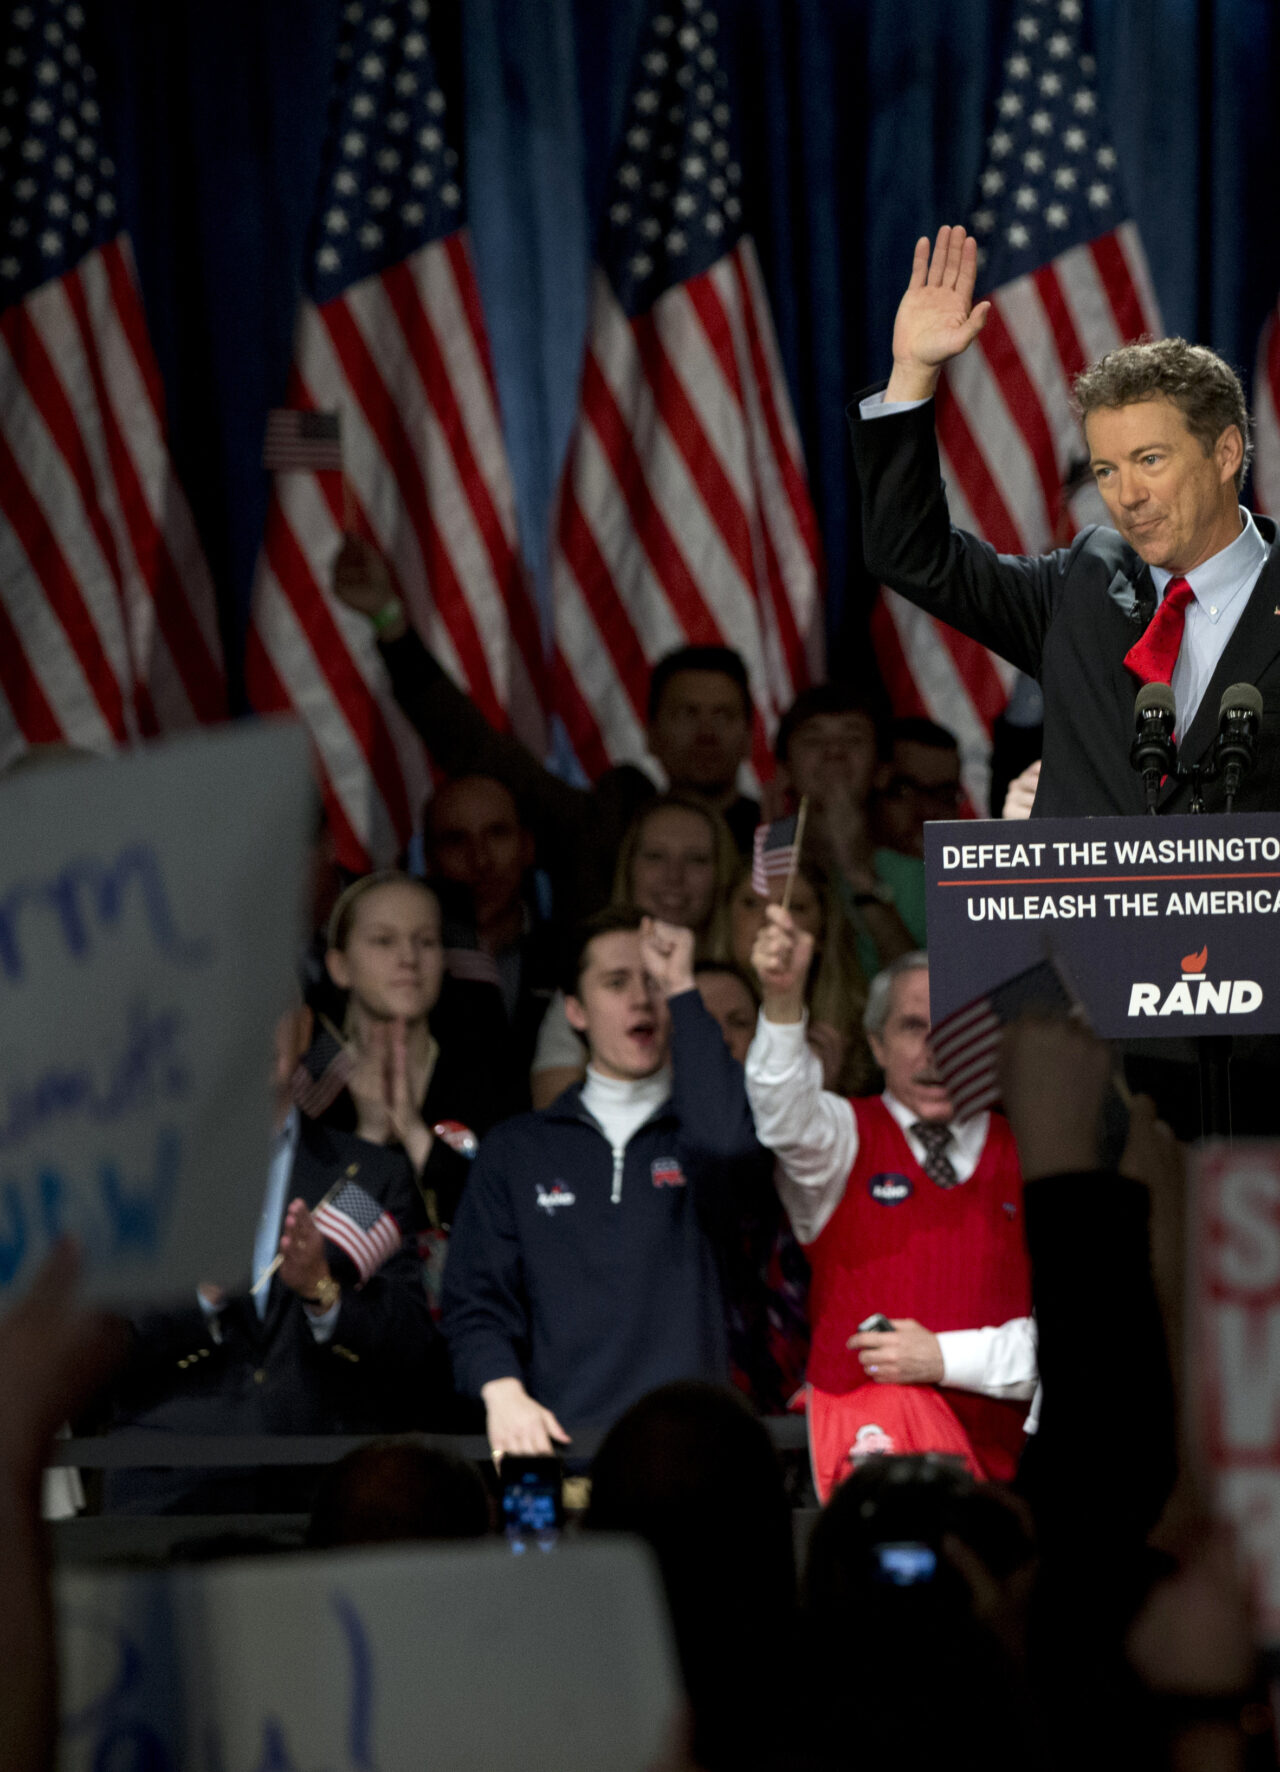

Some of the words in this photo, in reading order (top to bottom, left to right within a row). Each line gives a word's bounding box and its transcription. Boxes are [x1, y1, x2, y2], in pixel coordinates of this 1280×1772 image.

[942, 843, 1047, 870] DEFEAT
[1052, 841, 1108, 867] THE
[967, 894, 1097, 922] UNLEASH
[1103, 892, 1159, 918] THE
[1127, 979, 1264, 1017] RAND
